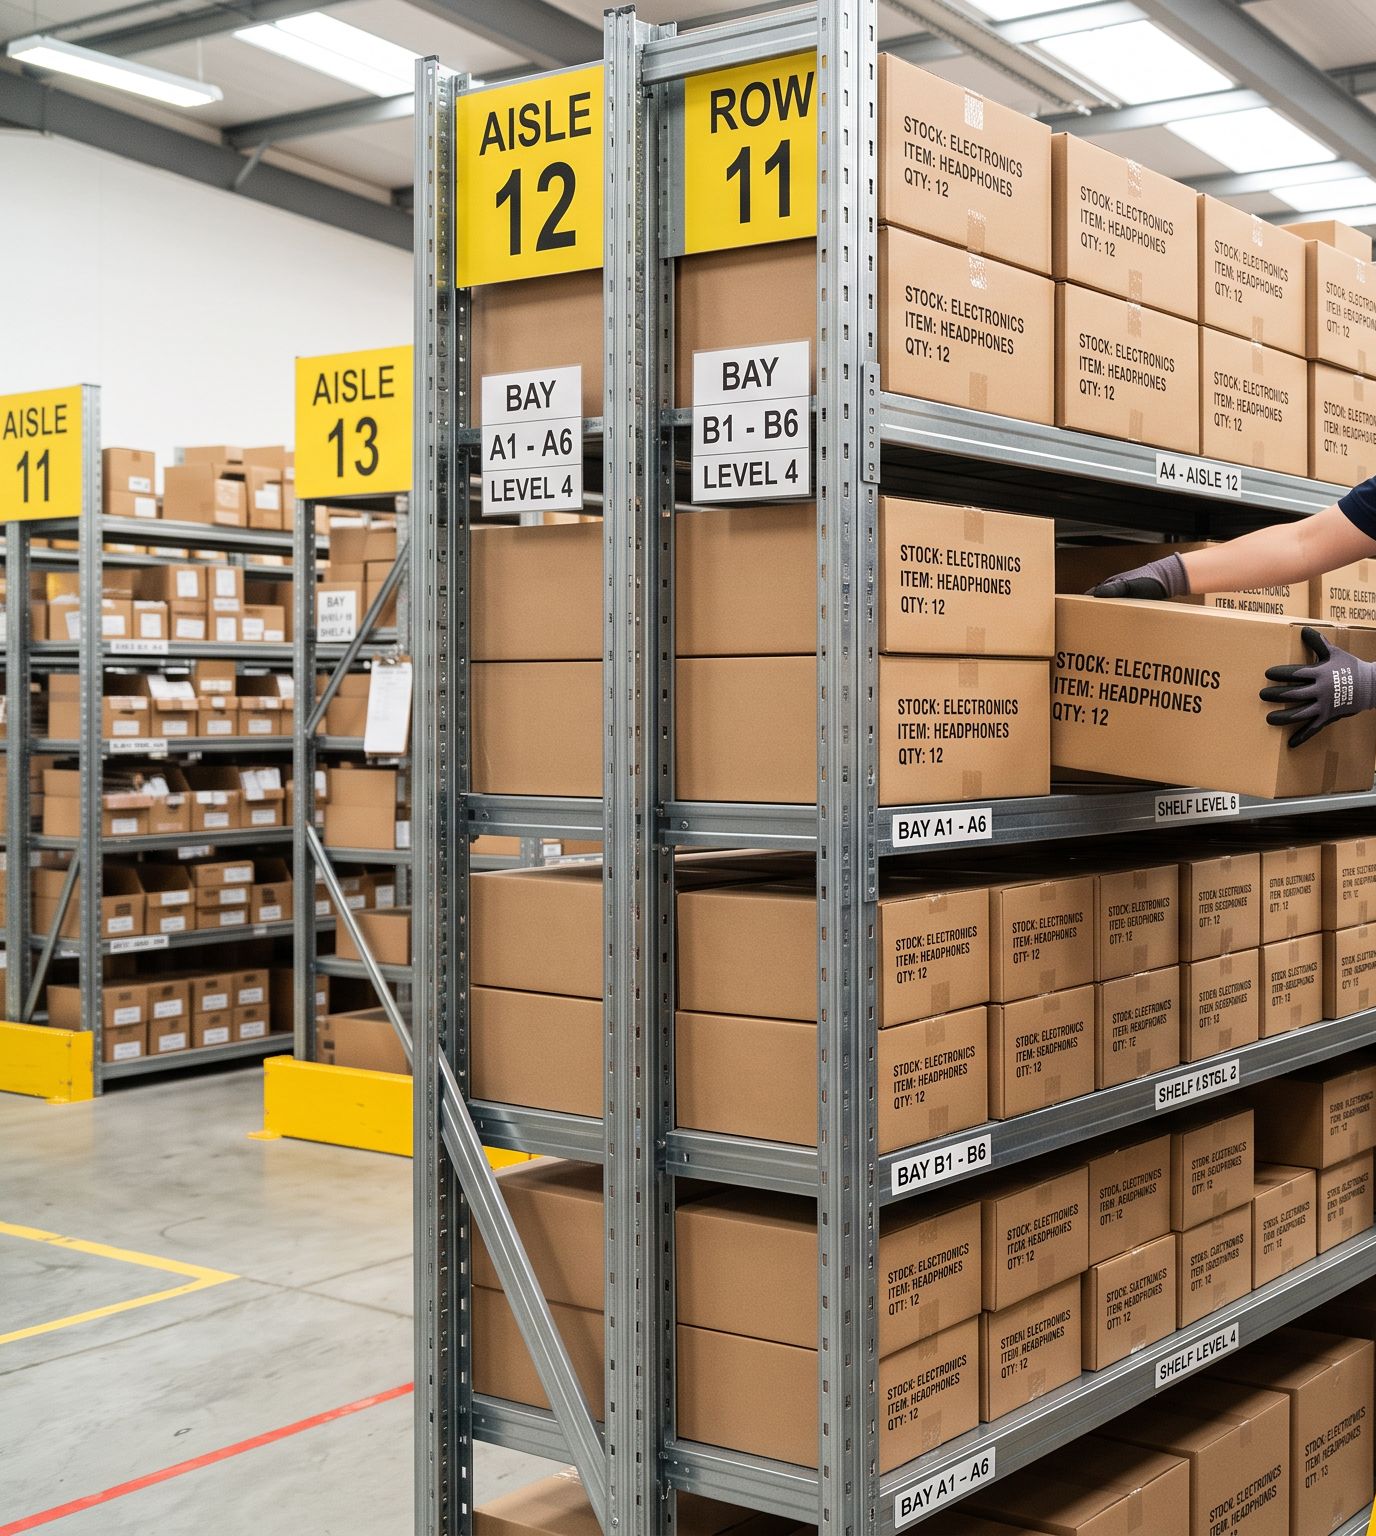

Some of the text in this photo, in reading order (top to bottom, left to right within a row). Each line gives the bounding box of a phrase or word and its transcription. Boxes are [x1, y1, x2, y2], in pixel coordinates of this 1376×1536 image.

[710, 71, 815, 134] ROW
[479, 91, 591, 156] AISLE
[904, 115, 1023, 178] STOCK: ELECTRONICS
[726, 139, 791, 224] 11
[904, 141, 1013, 198] ITEM: HEADPHONES
[904, 167, 949, 198] QTY: 12
[495, 161, 576, 256] 12
[905, 285, 1024, 334] STOCK: ELECTRONICS
[905, 311, 1014, 355] ITEM: HEADPHONES
[905, 337, 950, 363] QTY: 12
[1079, 355, 1105, 376] ITEM:
[1116, 343, 1175, 372] ELECTRONICS
[312, 364, 395, 406] AISLE
[722, 356, 779, 391] BAY
[506, 380, 556, 412] BAY
[3, 404, 68, 440] AISLE
[703, 414, 732, 445] B1
[764, 408, 798, 439] B6
[327, 416, 379, 478] 13
[489, 432, 516, 461] A1
[541, 428, 573, 457] A6
[16, 448, 50, 503] 11
[491, 475, 573, 503] LEVEL 4
[704, 459, 798, 489] LEVEL 4
[1160, 462, 1176, 481] A4
[1186, 467, 1222, 489] AISLE
[1226, 473, 1238, 492] 12
[900, 544, 1021, 572] STOCK: ELECTRONICS
[900, 570, 1011, 595] ITEM: HEADPHONES
[327, 597, 344, 608] BAY
[901, 596, 945, 615] QTY: 12
[1056, 651, 1221, 690] STOCK: ELECTRONICS
[943, 699, 1018, 715] ELECTRONICS
[1054, 677, 1202, 714] ITEM: HEADPHONES
[1053, 702, 1109, 726] QTY: 12
[934, 723, 1009, 739] HEADPHONES
[1158, 796, 1236, 817] SHELF LEVEL 6
[899, 819, 930, 840] BAY
[934, 818, 952, 837] A1
[967, 815, 986, 834] A6
[915, 1091, 925, 1103] 12
[1159, 1079, 1194, 1103] SHELF
[898, 1159, 931, 1187] BAY
[934, 1154, 953, 1175] B1
[967, 1143, 987, 1165] B6
[1160, 1330, 1236, 1380] SHELF LEVEL 4
[910, 1408, 918, 1422] 12
[901, 1485, 933, 1517] BAY
[937, 1474, 955, 1498] A1
[970, 1458, 989, 1482] A6
